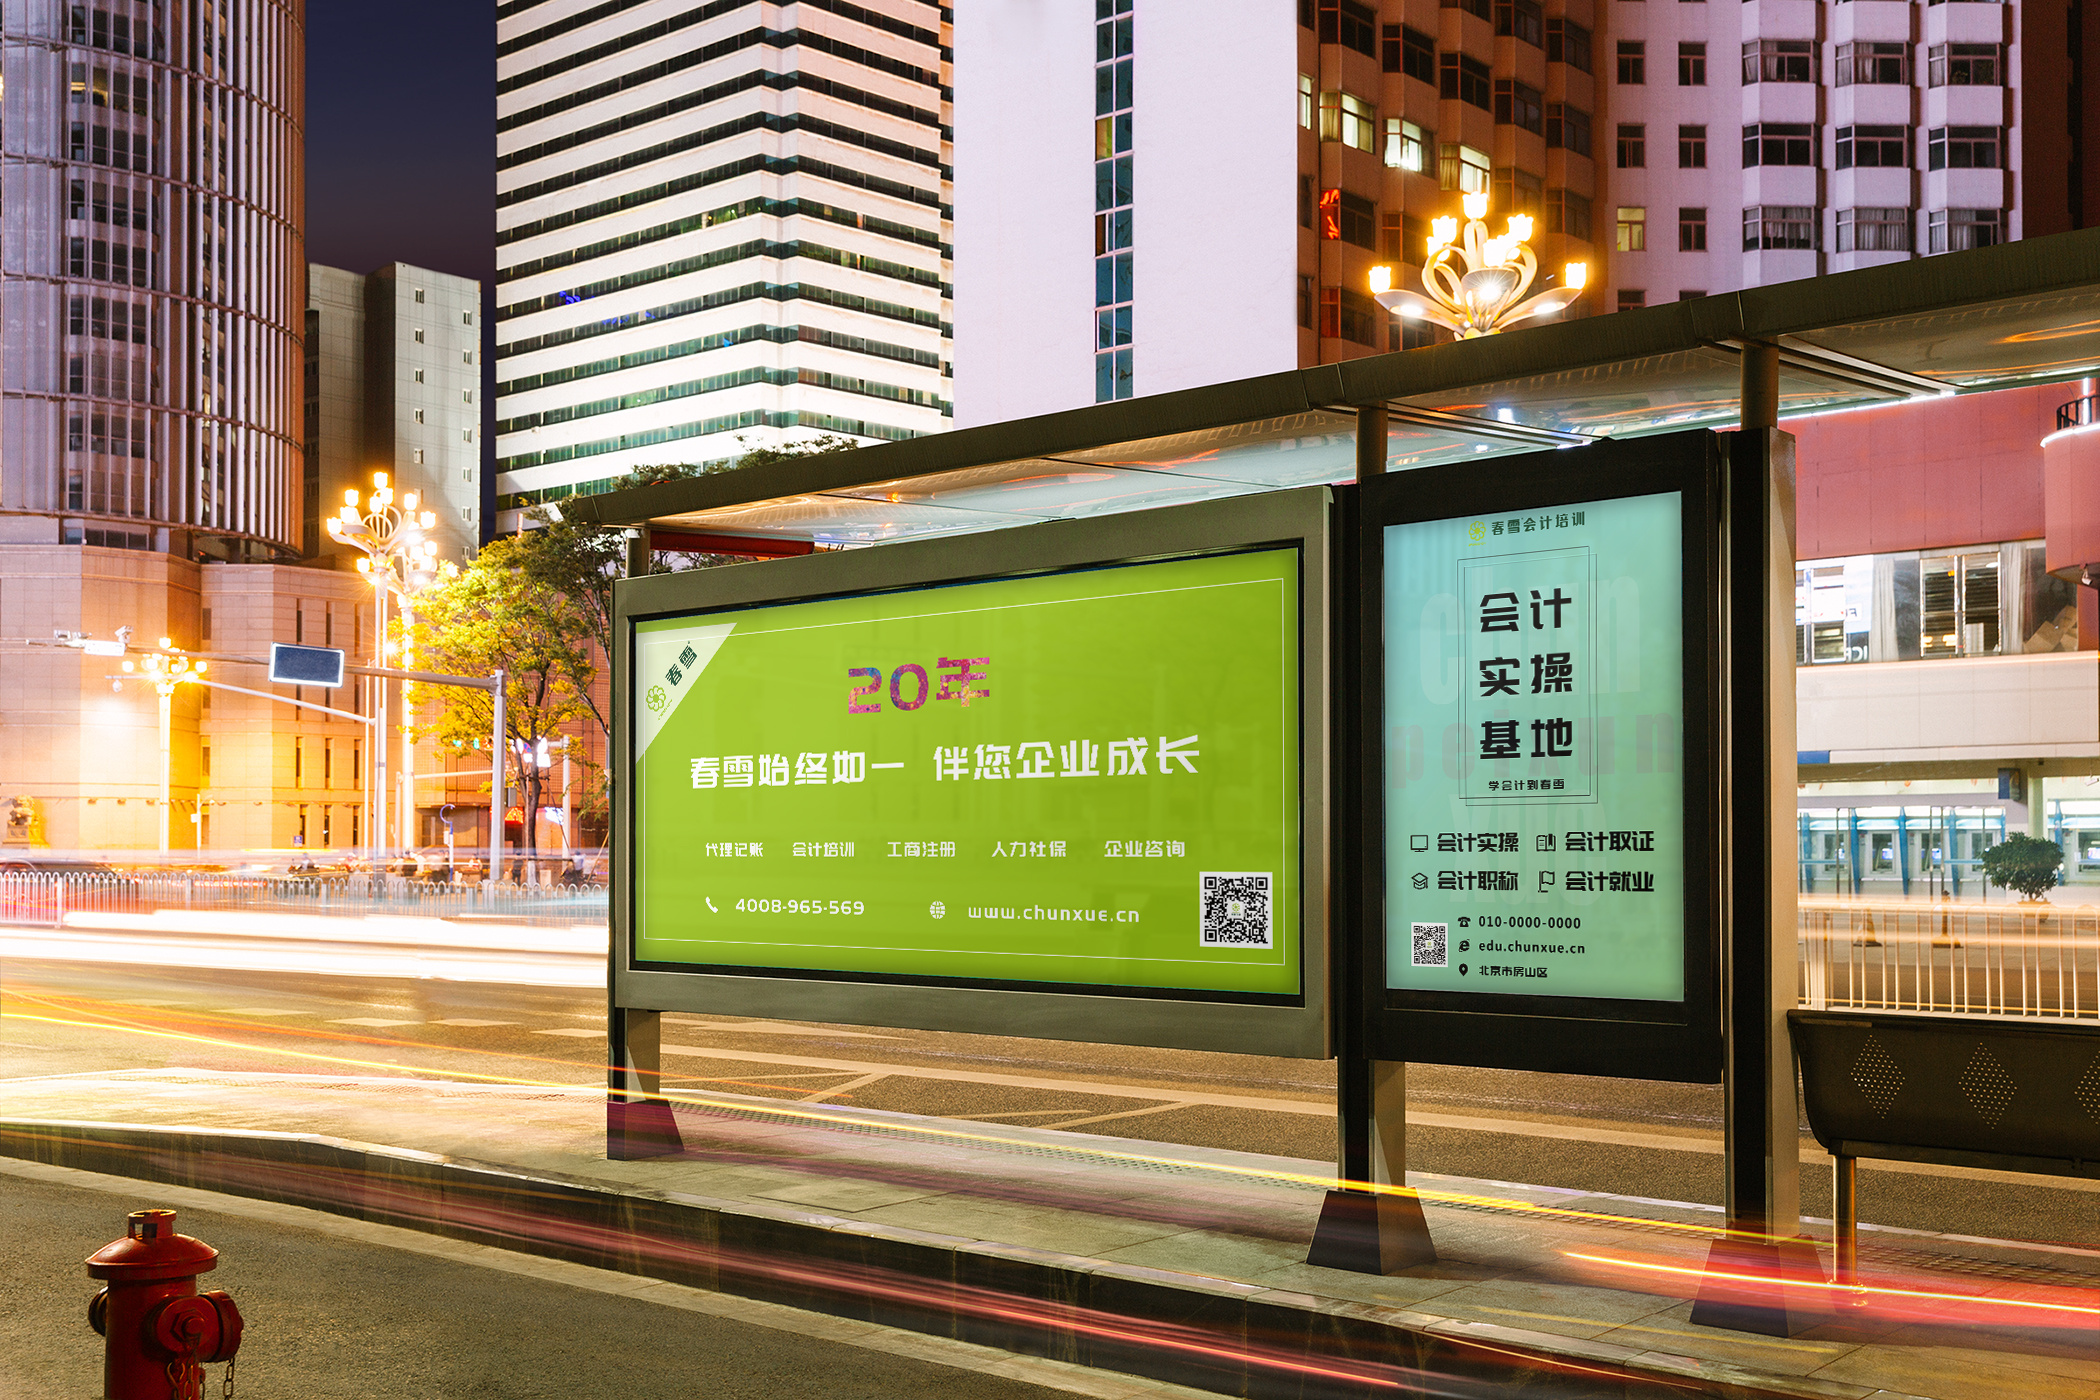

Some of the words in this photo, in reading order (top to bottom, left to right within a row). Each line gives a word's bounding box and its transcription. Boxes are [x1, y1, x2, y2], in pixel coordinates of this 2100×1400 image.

[1491, 511, 1585, 536] 春雪会计培训
[1479, 588, 1572, 632] 会计
[664, 645, 698, 687] 春雪
[1479, 652, 1573, 697] 实操
[848, 656, 990, 715] 20年
[1479, 717, 1573, 760] 基地
[690, 750, 905, 790] 春雪始终如一
[932, 734, 1200, 782] 伴您企业成长
[1488, 778, 1565, 792] 学会计到春雪
[705, 842, 764, 858] 代理记账
[792, 841, 855, 858] 会计培训
[887, 841, 956, 858] 工商注册
[991, 840, 1067, 858] 人力社保
[1103, 840, 1186, 858] 企业咨询
[1437, 832, 1519, 853] 会计实操
[1565, 830, 1655, 852] 会计取证
[1437, 870, 1519, 891] 会计职称
[1565, 870, 1655, 893] 会计就业
[735, 898, 865, 916] 4008-965-569
[968, 904, 1140, 923] www.chunxue.cn
[1478, 915, 1581, 930] 010-0000-0000
[1478, 939, 1585, 954] edu.chunxue.cn
[1478, 965, 1548, 979] 北京市房山区
